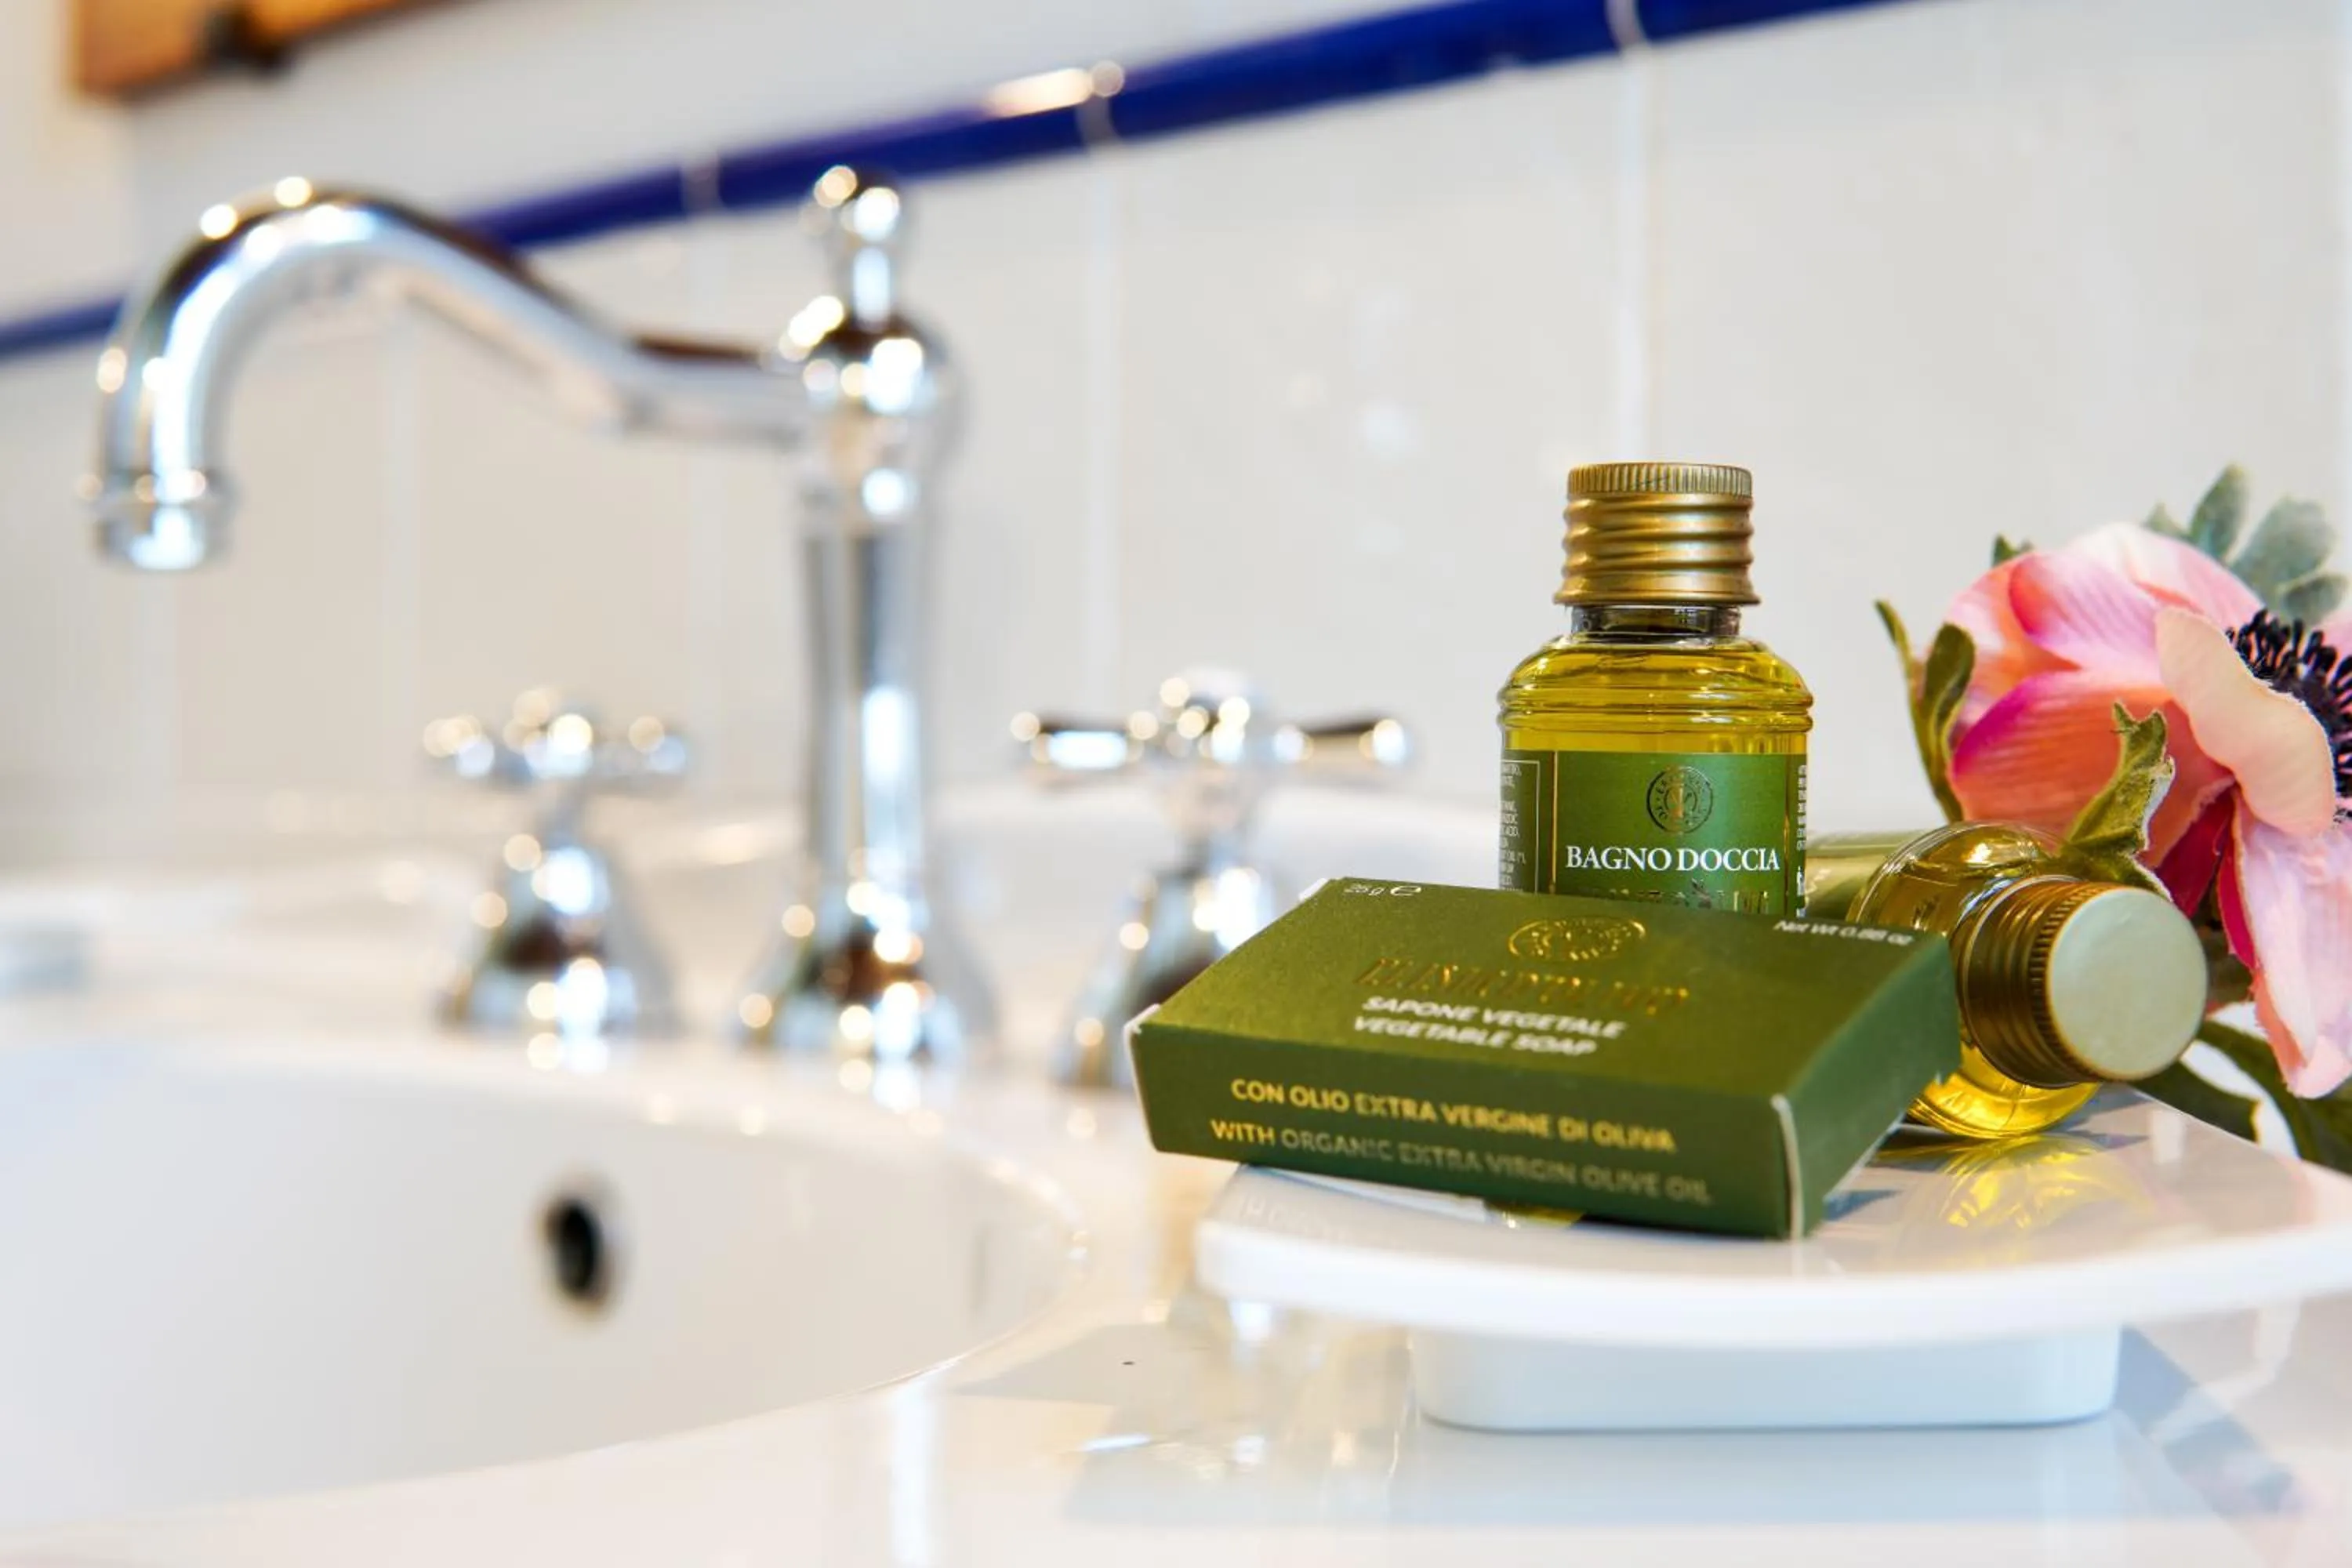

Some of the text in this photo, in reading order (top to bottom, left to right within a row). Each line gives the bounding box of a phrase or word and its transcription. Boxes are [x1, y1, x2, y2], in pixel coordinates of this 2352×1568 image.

[1566, 845, 1780, 872] BAGNO DOCCIA
[1354, 1016, 1598, 1057] VEGETABLE SOAP
[1362, 995, 1629, 1040] SAPONE VEGETALE
[1230, 1078, 1678, 1154] CON OLIO EXTRA VERGINE DI OLIVA
[1210, 1118, 1712, 1206] WITH ORGANIC EXTRA VIRGIN OLIVE OIL
